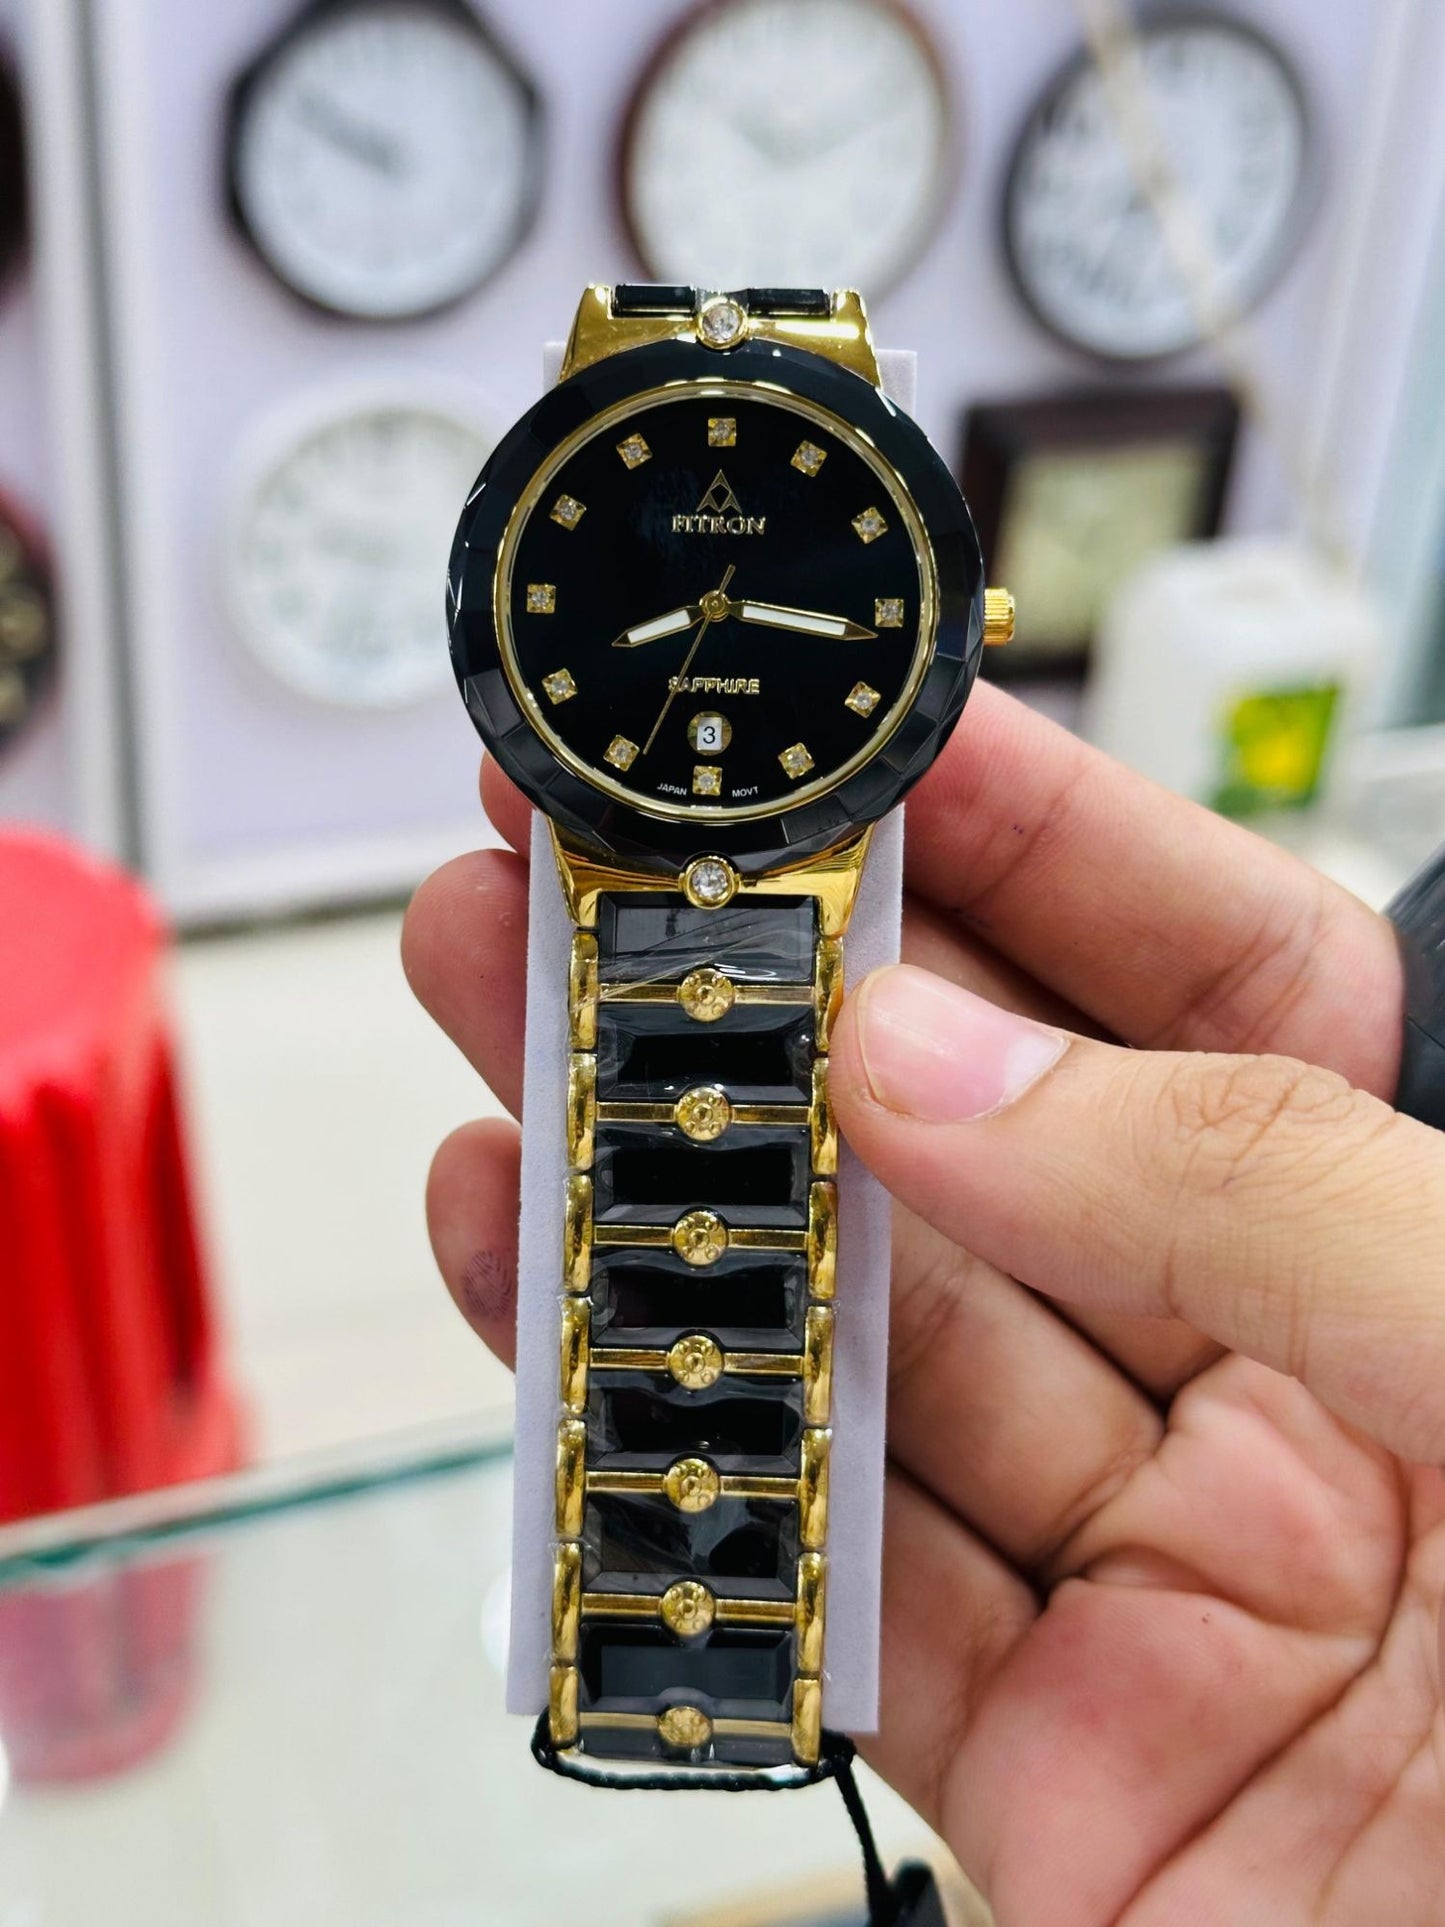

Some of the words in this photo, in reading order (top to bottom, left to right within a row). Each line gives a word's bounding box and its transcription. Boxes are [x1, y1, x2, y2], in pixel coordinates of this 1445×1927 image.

[668, 676, 760, 694] SAPPHIRE
[703, 726, 716, 744] 3
[657, 783, 687, 796] JAPAN
[731, 786, 759, 798] MOVT
